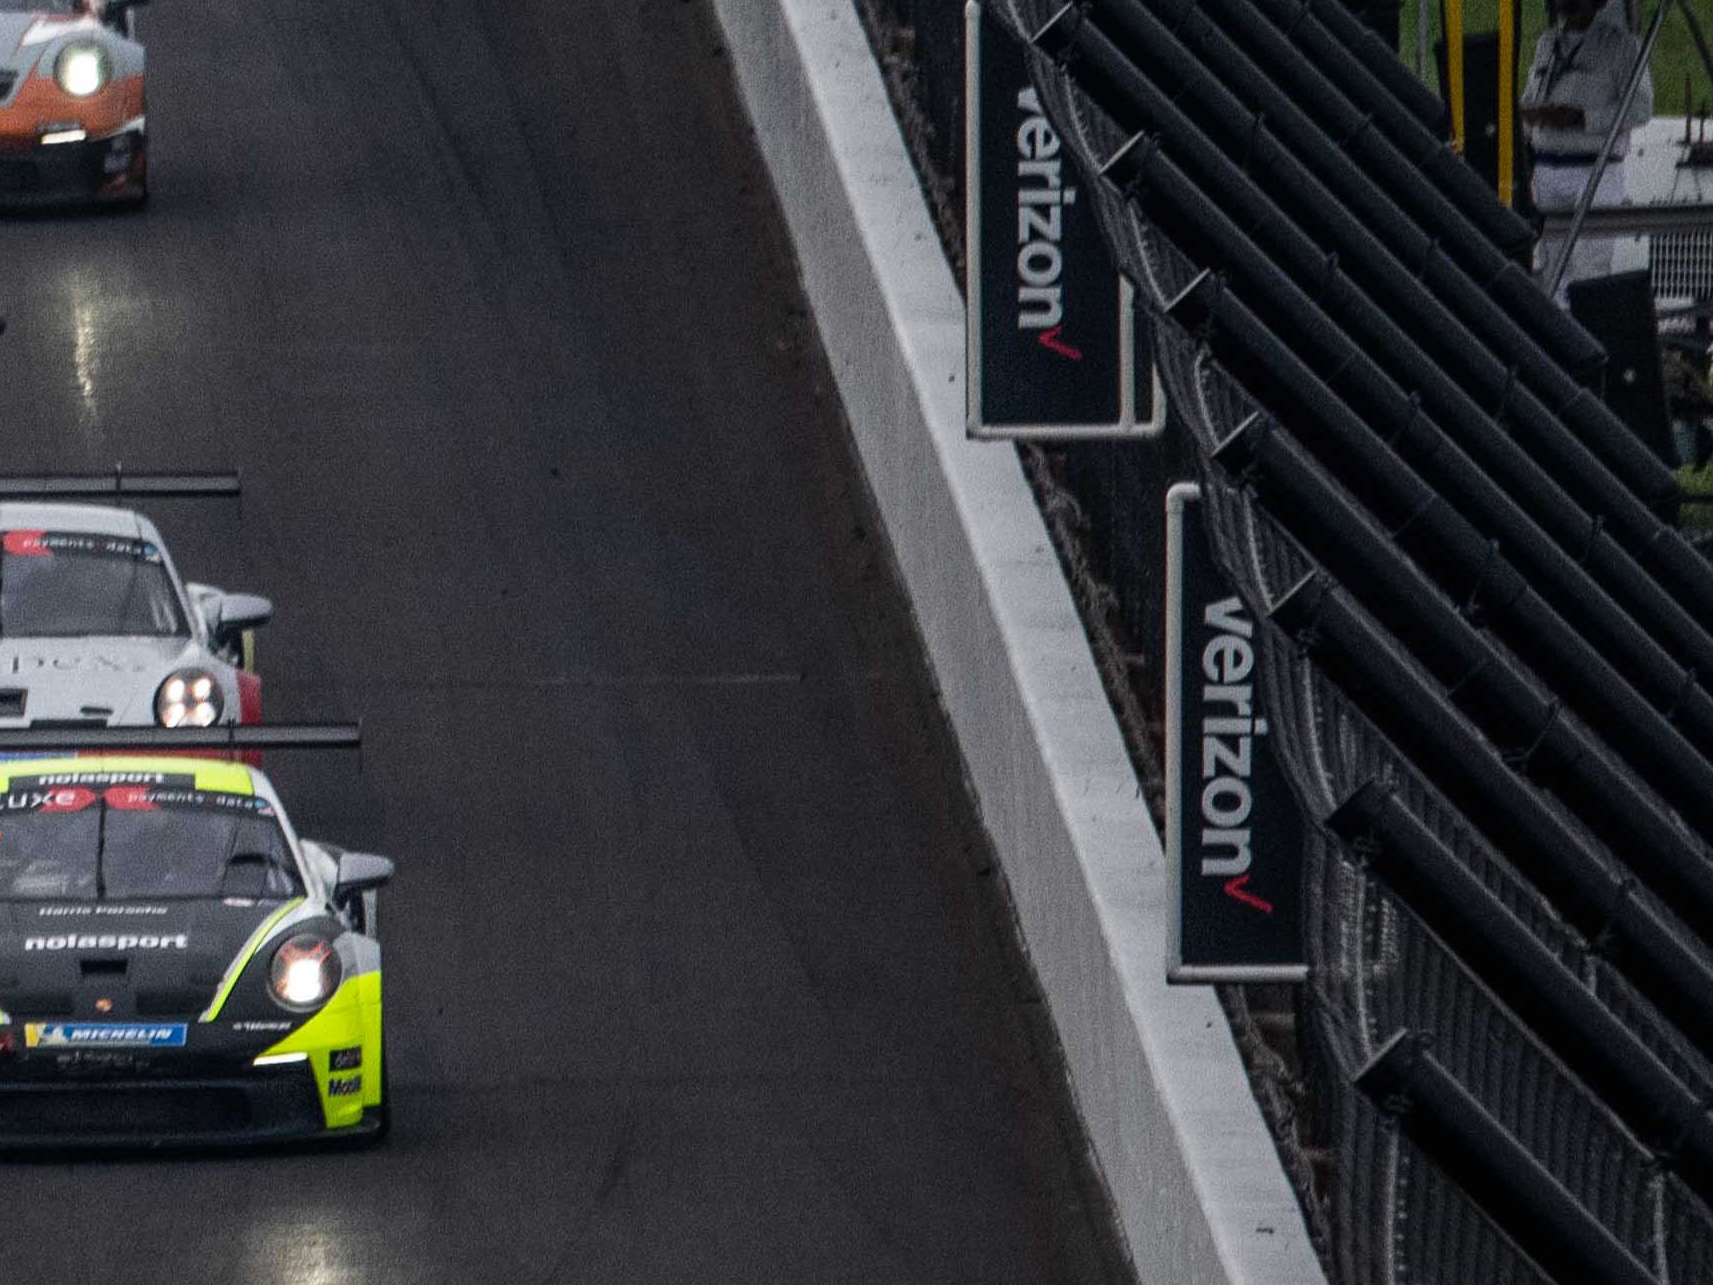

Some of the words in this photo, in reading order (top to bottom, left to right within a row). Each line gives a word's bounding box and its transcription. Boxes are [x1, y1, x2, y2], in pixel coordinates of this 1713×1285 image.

[1199, 597, 1252, 876] verizon
[38, 773, 165, 785] nolasport
[127, 791, 204, 804] payments
[25, 934, 190, 951] nolasport
[71, 1027, 172, 1040] MICHELIN
